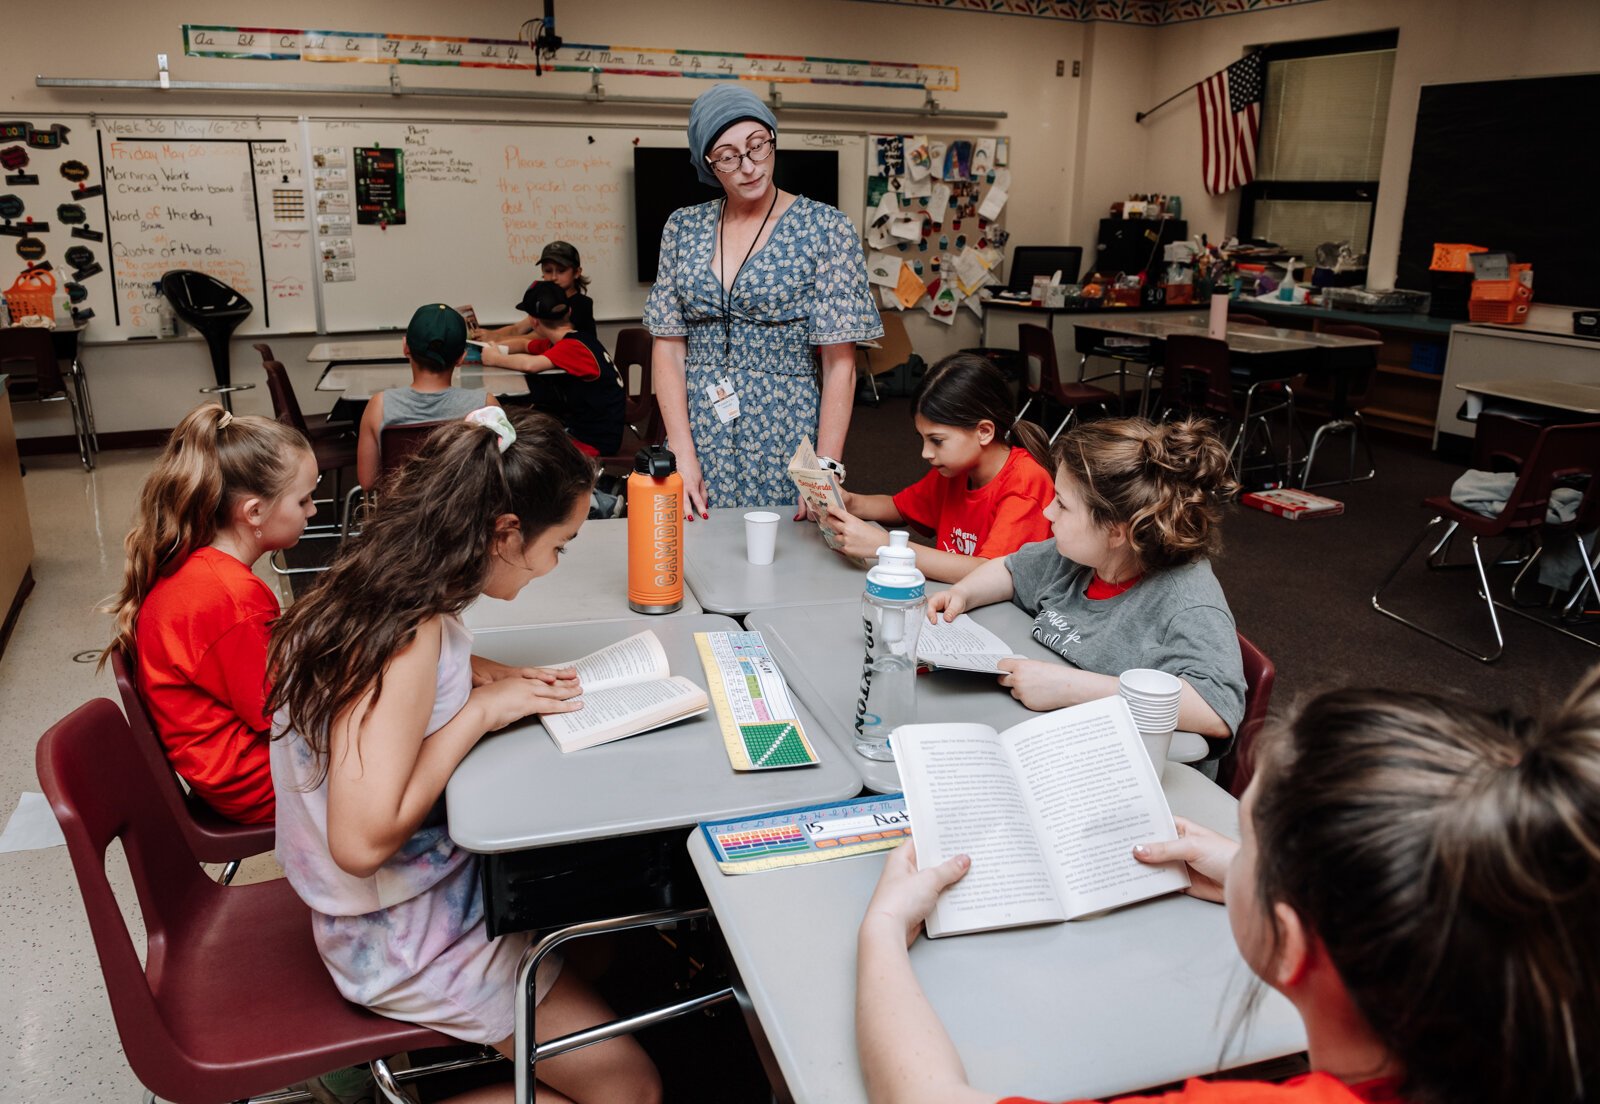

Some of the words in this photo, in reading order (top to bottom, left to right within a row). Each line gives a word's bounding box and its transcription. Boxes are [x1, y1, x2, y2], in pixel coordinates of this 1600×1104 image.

[195, 33, 215, 46] Aa
[237, 34, 255, 46] Bb
[280, 36, 295, 49] Cc
[345, 39, 360, 51] Ee
[575, 50, 591, 62] Ll
[599, 52, 625, 64] Mm
[636, 54, 655, 66] Nn
[102, 119, 143, 134] Week
[145, 119, 165, 133] 36
[174, 120, 205, 137] May
[110, 142, 160, 164] Friday
[162, 145, 186, 162] May
[253, 143, 276, 155] How
[279, 144, 291, 153] do
[280, 157, 291, 166] to
[504, 144, 546, 170] Please
[554, 154, 612, 173] complete
[105, 166, 159, 186] Morning
[160, 167, 190, 181] Work
[118, 183, 151, 193] Check
[161, 183, 178, 192] the
[180, 183, 204, 193] front
[207, 183, 234, 193] board
[496, 177, 520, 193] the
[525, 177, 567, 200] packet
[572, 183, 592, 193] on
[595, 183, 620, 200] your
[108, 209, 141, 222] Word
[145, 205, 160, 220] of
[166, 206, 189, 221] the
[190, 209, 212, 226] day
[550, 204, 572, 219] you
[502, 216, 538, 234] please
[545, 216, 589, 230] continue
[112, 241, 155, 257] Quote
[160, 240, 176, 258] of
[180, 243, 202, 255] the
[523, 235, 546, 249] your
[1147, 288, 1163, 301] 20
[654, 493, 678, 588] CAMDEN
[805, 821, 824, 834] 15
